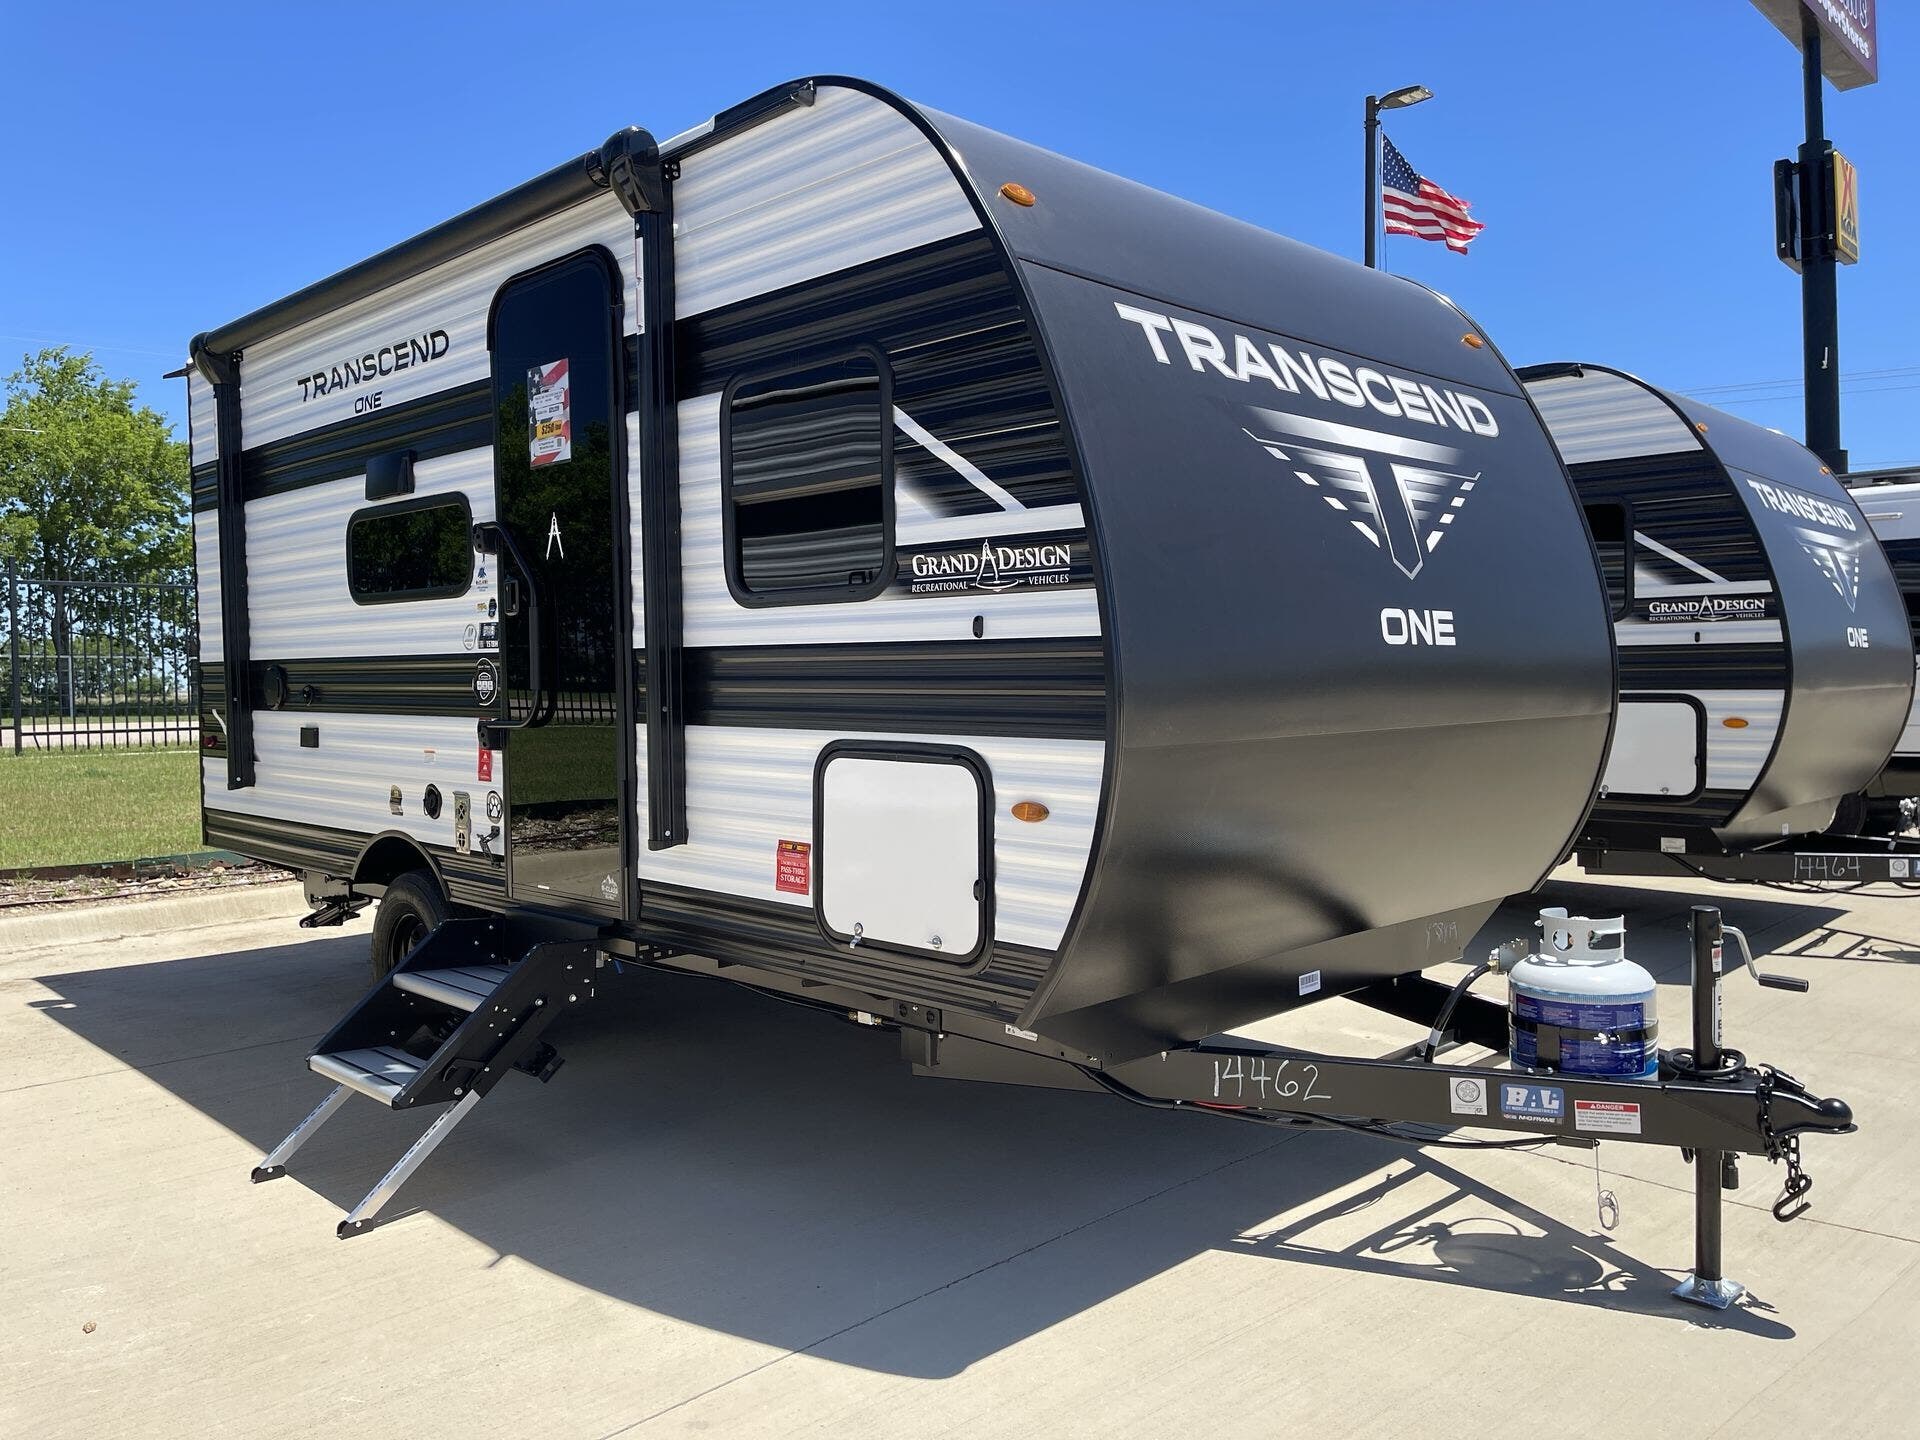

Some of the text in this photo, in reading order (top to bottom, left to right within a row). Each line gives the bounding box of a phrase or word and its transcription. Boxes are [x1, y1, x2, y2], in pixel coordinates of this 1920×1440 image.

[1817, 0, 1869, 58] uperStores
[297, 329, 450, 402] TRANSCEND
[1113, 301, 1501, 438] TRANSCEND
[354, 391, 383, 414] ONE
[1746, 479, 1857, 532] TRANSCEND
[911, 544, 1071, 577] GRAND DESIGN
[911, 574, 1070, 593] RECREATIONAL VEHICLES
[1648, 599, 1765, 613] GRAND DESIGN
[1380, 607, 1457, 646] ONE
[1847, 626, 1869, 649] ONE
[1794, 856, 1861, 880] 14464
[1213, 1055, 1332, 1101] 14462
[1506, 1086, 1560, 1110] BAL
[1596, 1103, 1625, 1111] DANGER
